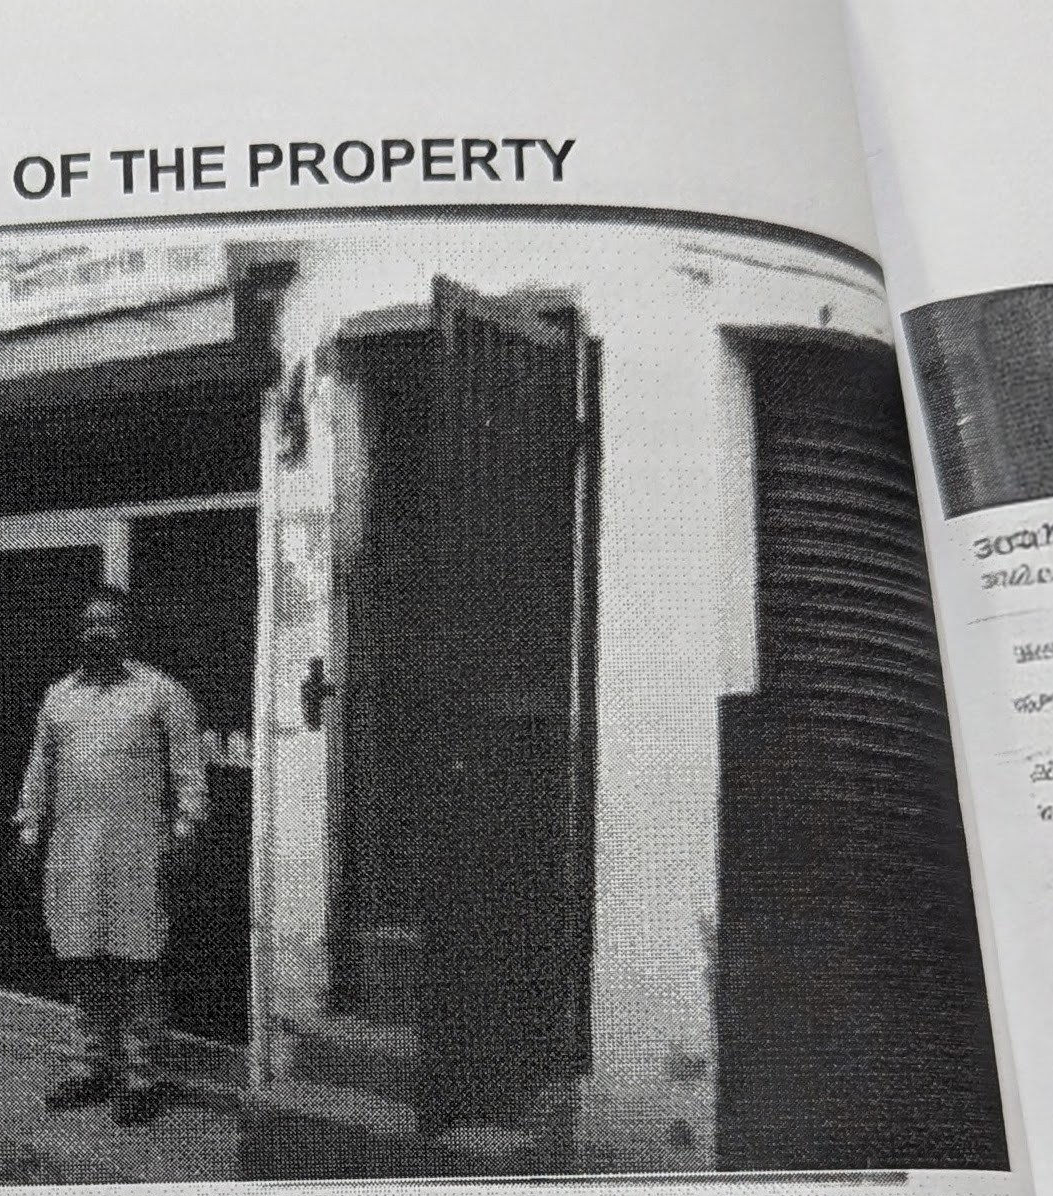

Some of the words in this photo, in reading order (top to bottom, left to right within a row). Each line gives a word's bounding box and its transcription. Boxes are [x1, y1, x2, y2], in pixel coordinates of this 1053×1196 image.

[13, 154, 89, 200] OF
[110, 145, 226, 194] THE
[249, 138, 576, 188] PROPERTY
